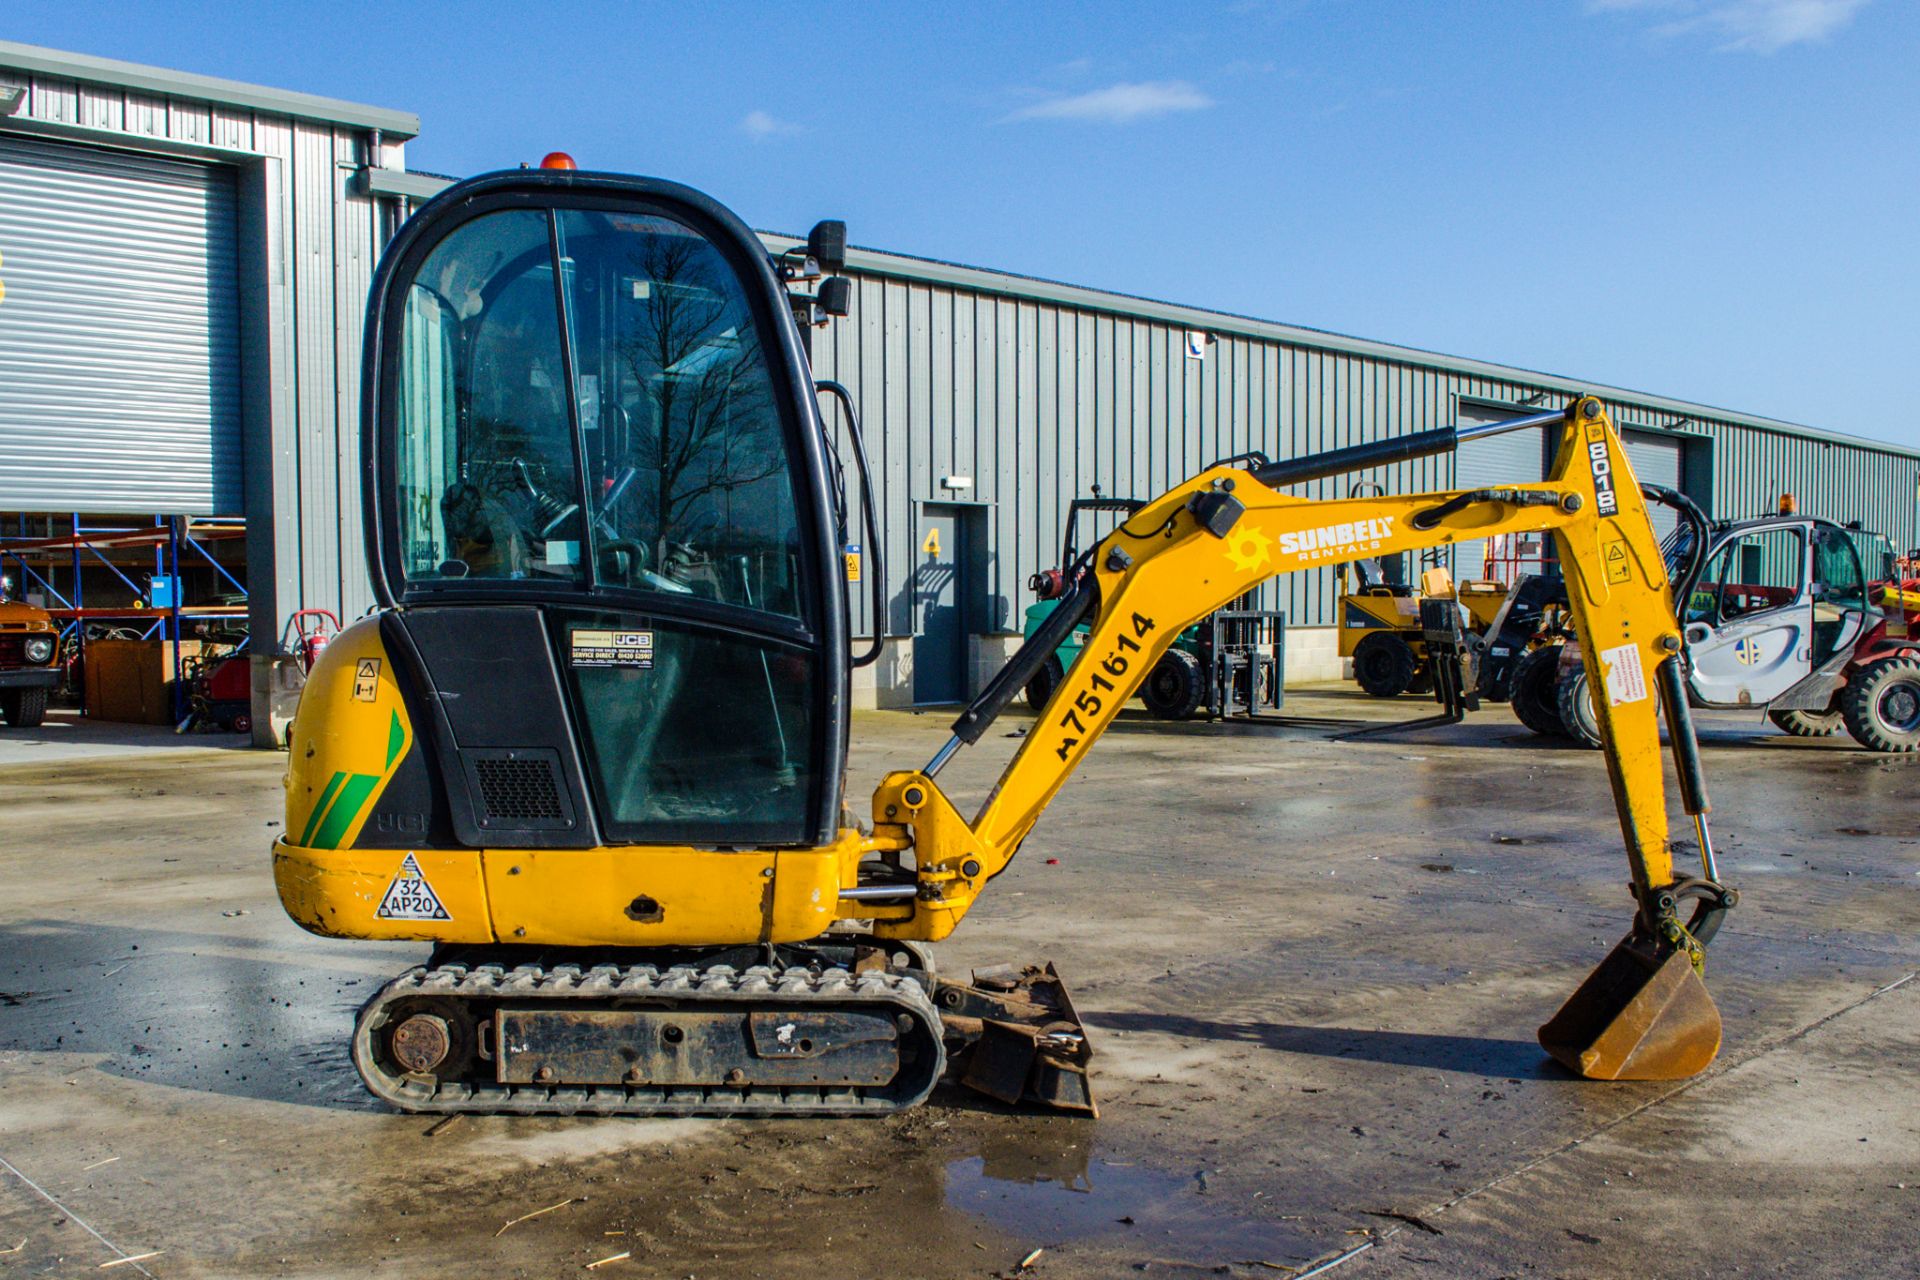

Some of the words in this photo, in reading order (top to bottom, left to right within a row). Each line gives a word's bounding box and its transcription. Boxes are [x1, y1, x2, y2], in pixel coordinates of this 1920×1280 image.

[1589, 441, 1616, 508] 8018
[922, 528, 941, 558] 4
[1279, 516, 1394, 554] SUNBELT
[1298, 540, 1381, 562] RENTALS
[616, 634, 650, 645] JCB
[400, 879, 421, 895] 32
[391, 897, 433, 912] AP20
